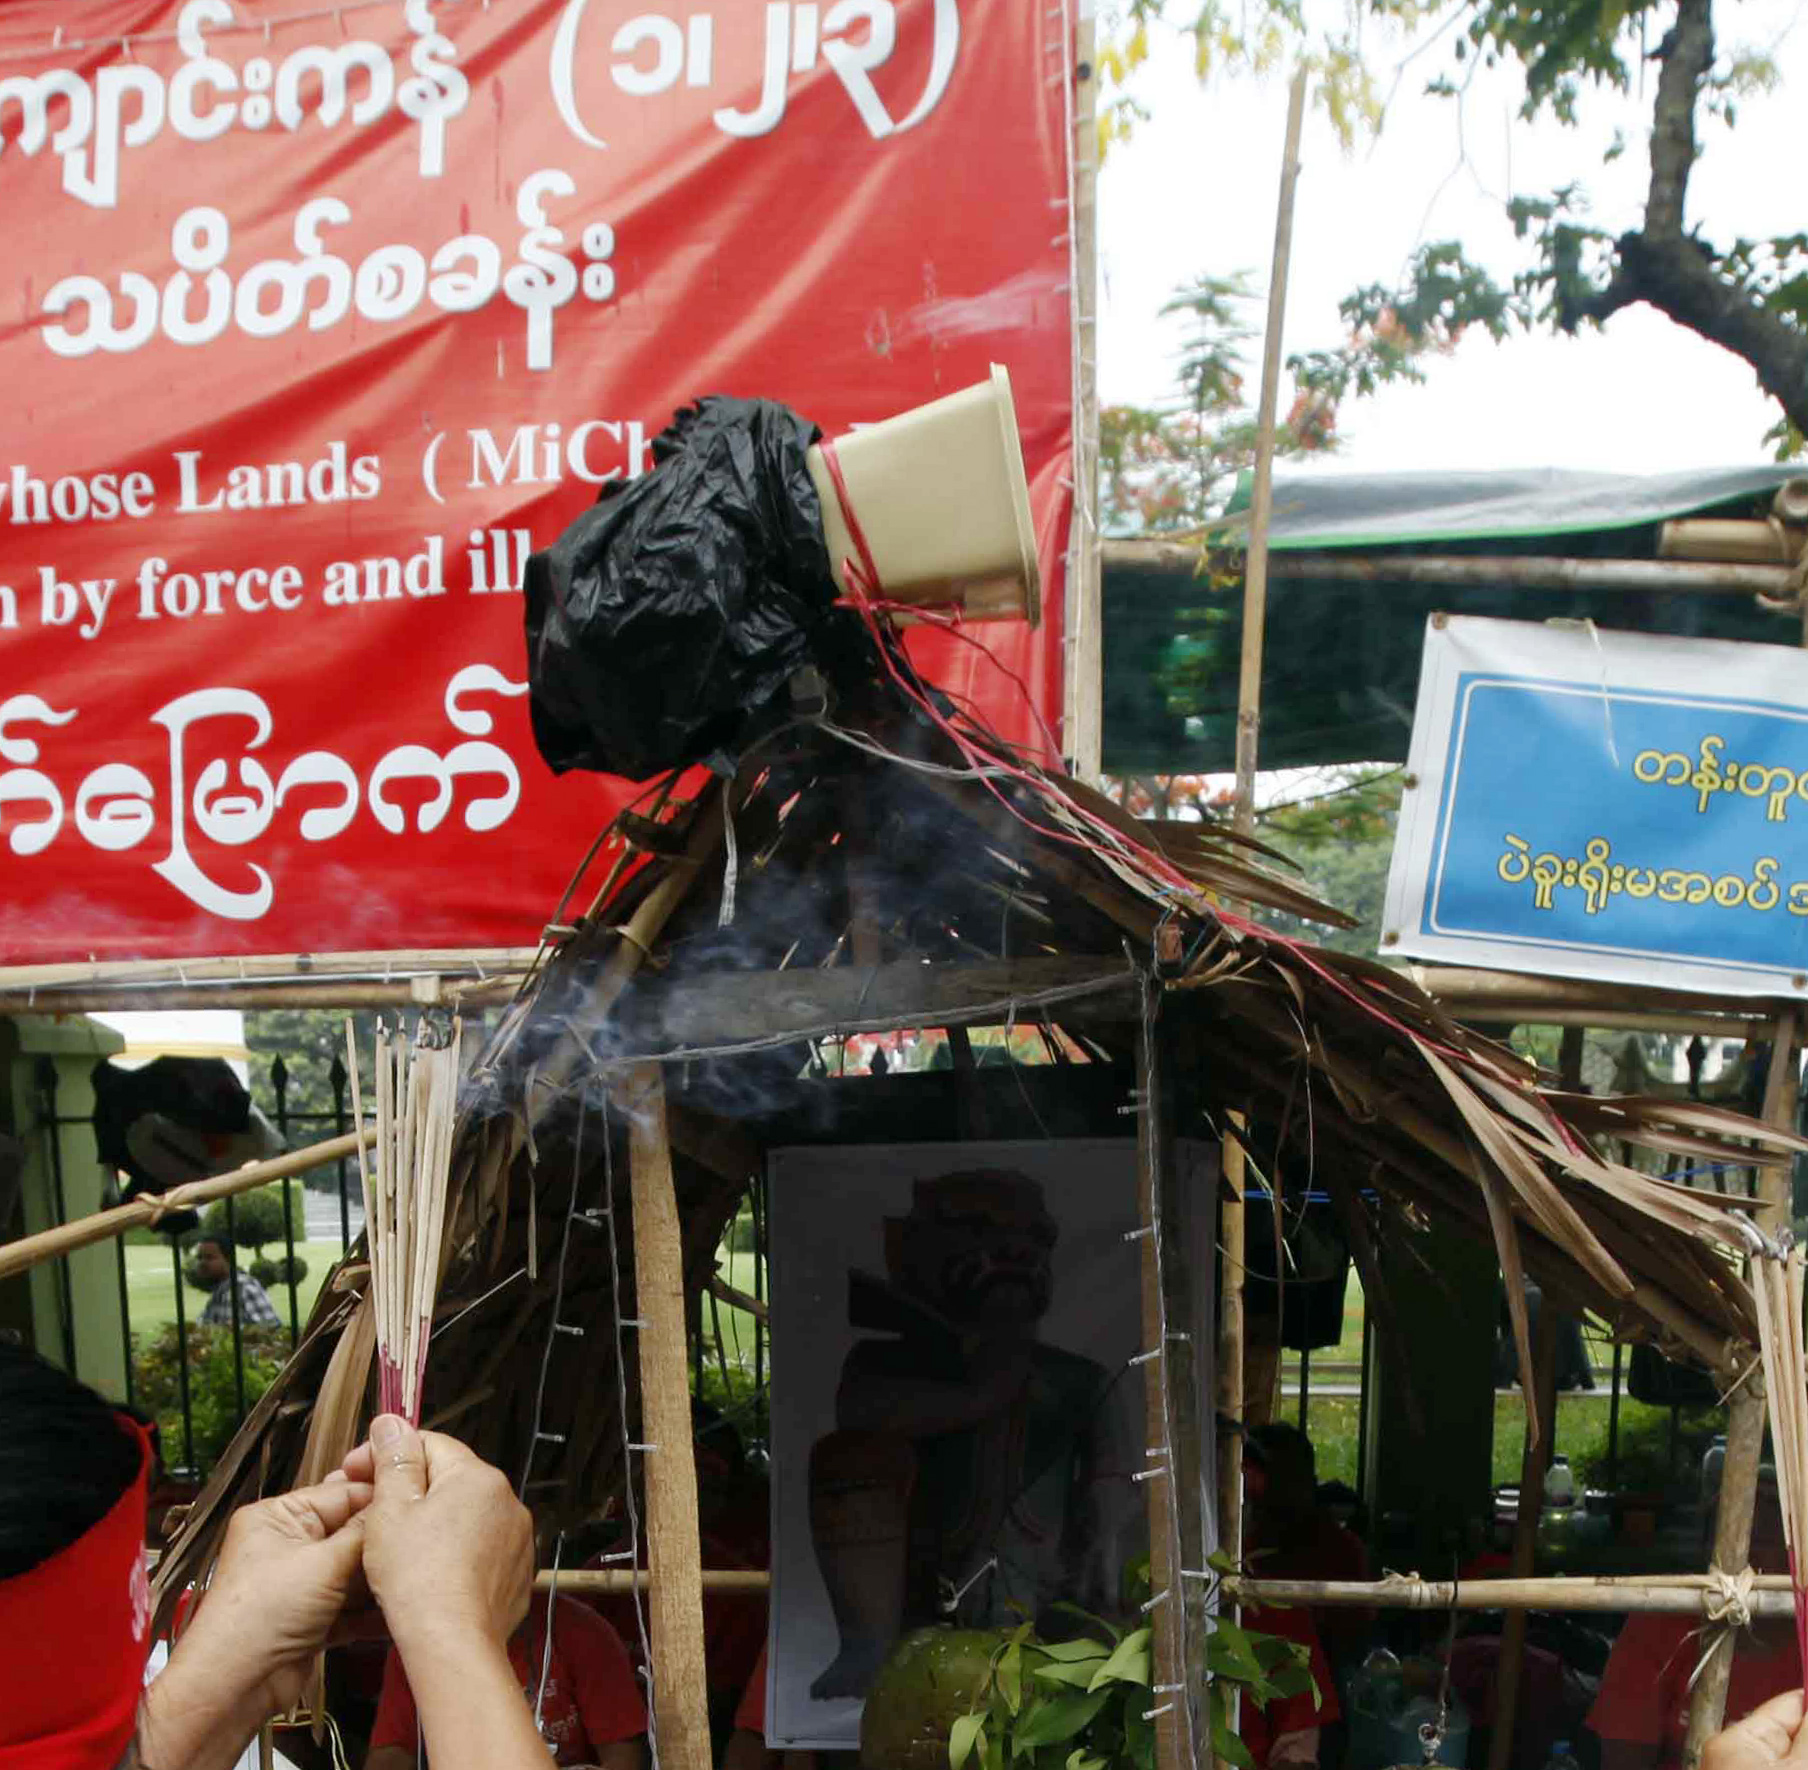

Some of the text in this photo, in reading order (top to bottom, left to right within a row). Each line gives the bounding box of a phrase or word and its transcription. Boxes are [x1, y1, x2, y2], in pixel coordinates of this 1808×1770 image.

[40, 168, 615, 370] သပိတ်စခန်း
[174, 441, 381, 513] Lands
[40, 567, 117, 638] by
[136, 556, 302, 619] force
[324, 536, 446, 601] and
